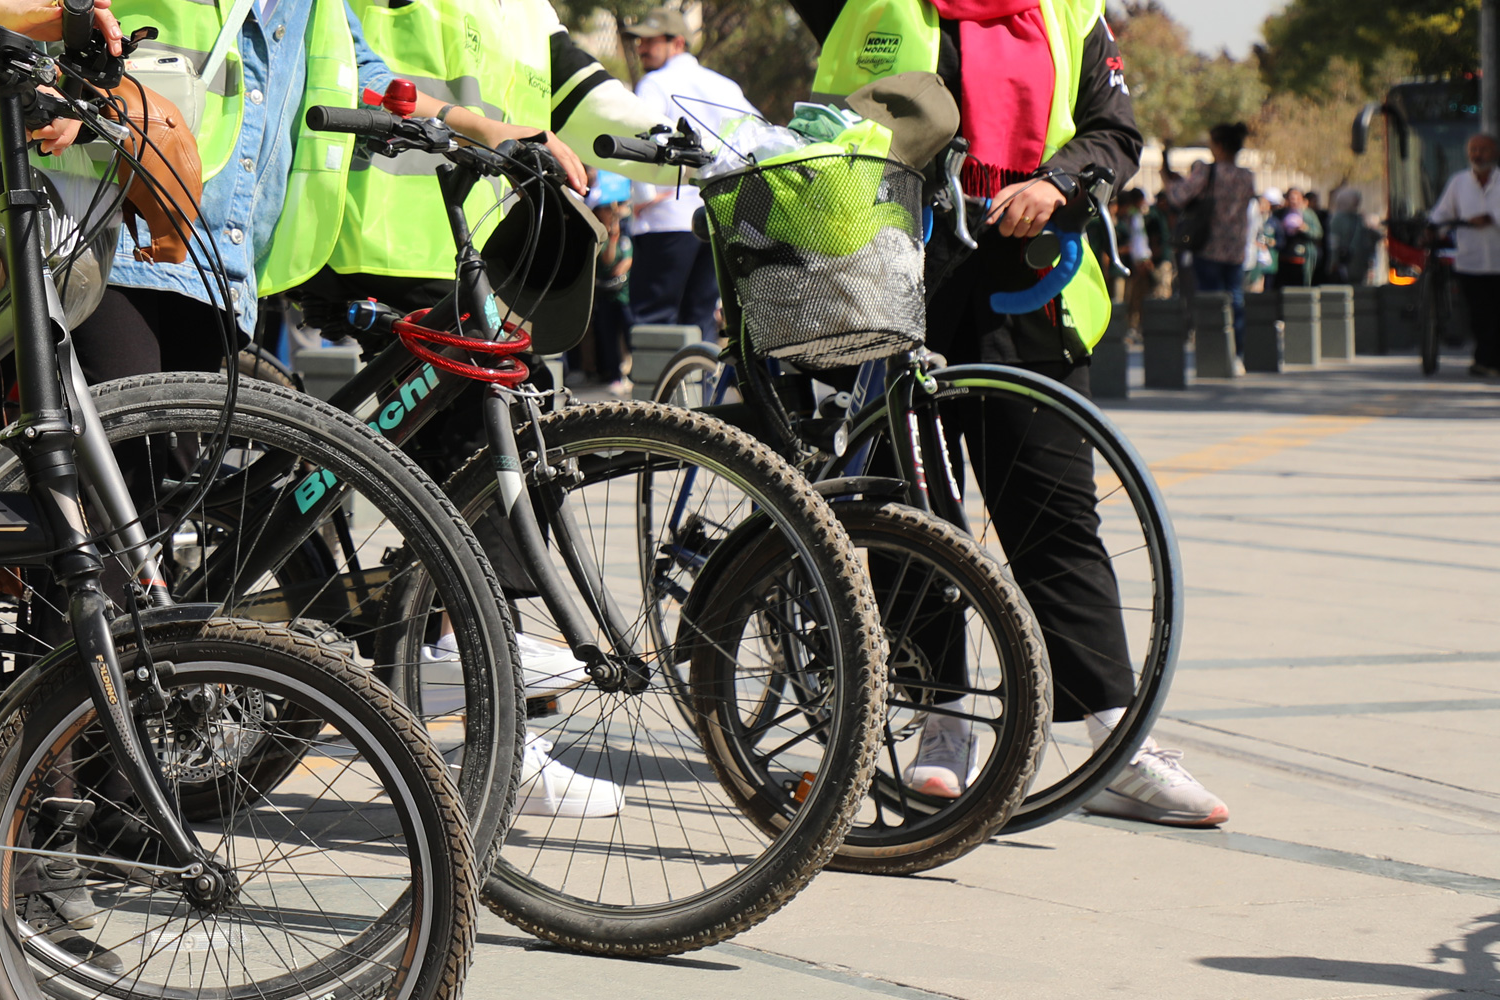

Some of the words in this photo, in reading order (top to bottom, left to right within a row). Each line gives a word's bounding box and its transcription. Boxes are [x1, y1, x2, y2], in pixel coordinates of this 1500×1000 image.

[867, 37, 899, 46] KONYA
[294, 362, 441, 515] Bichi
[95, 653, 118, 706] FOLDING
